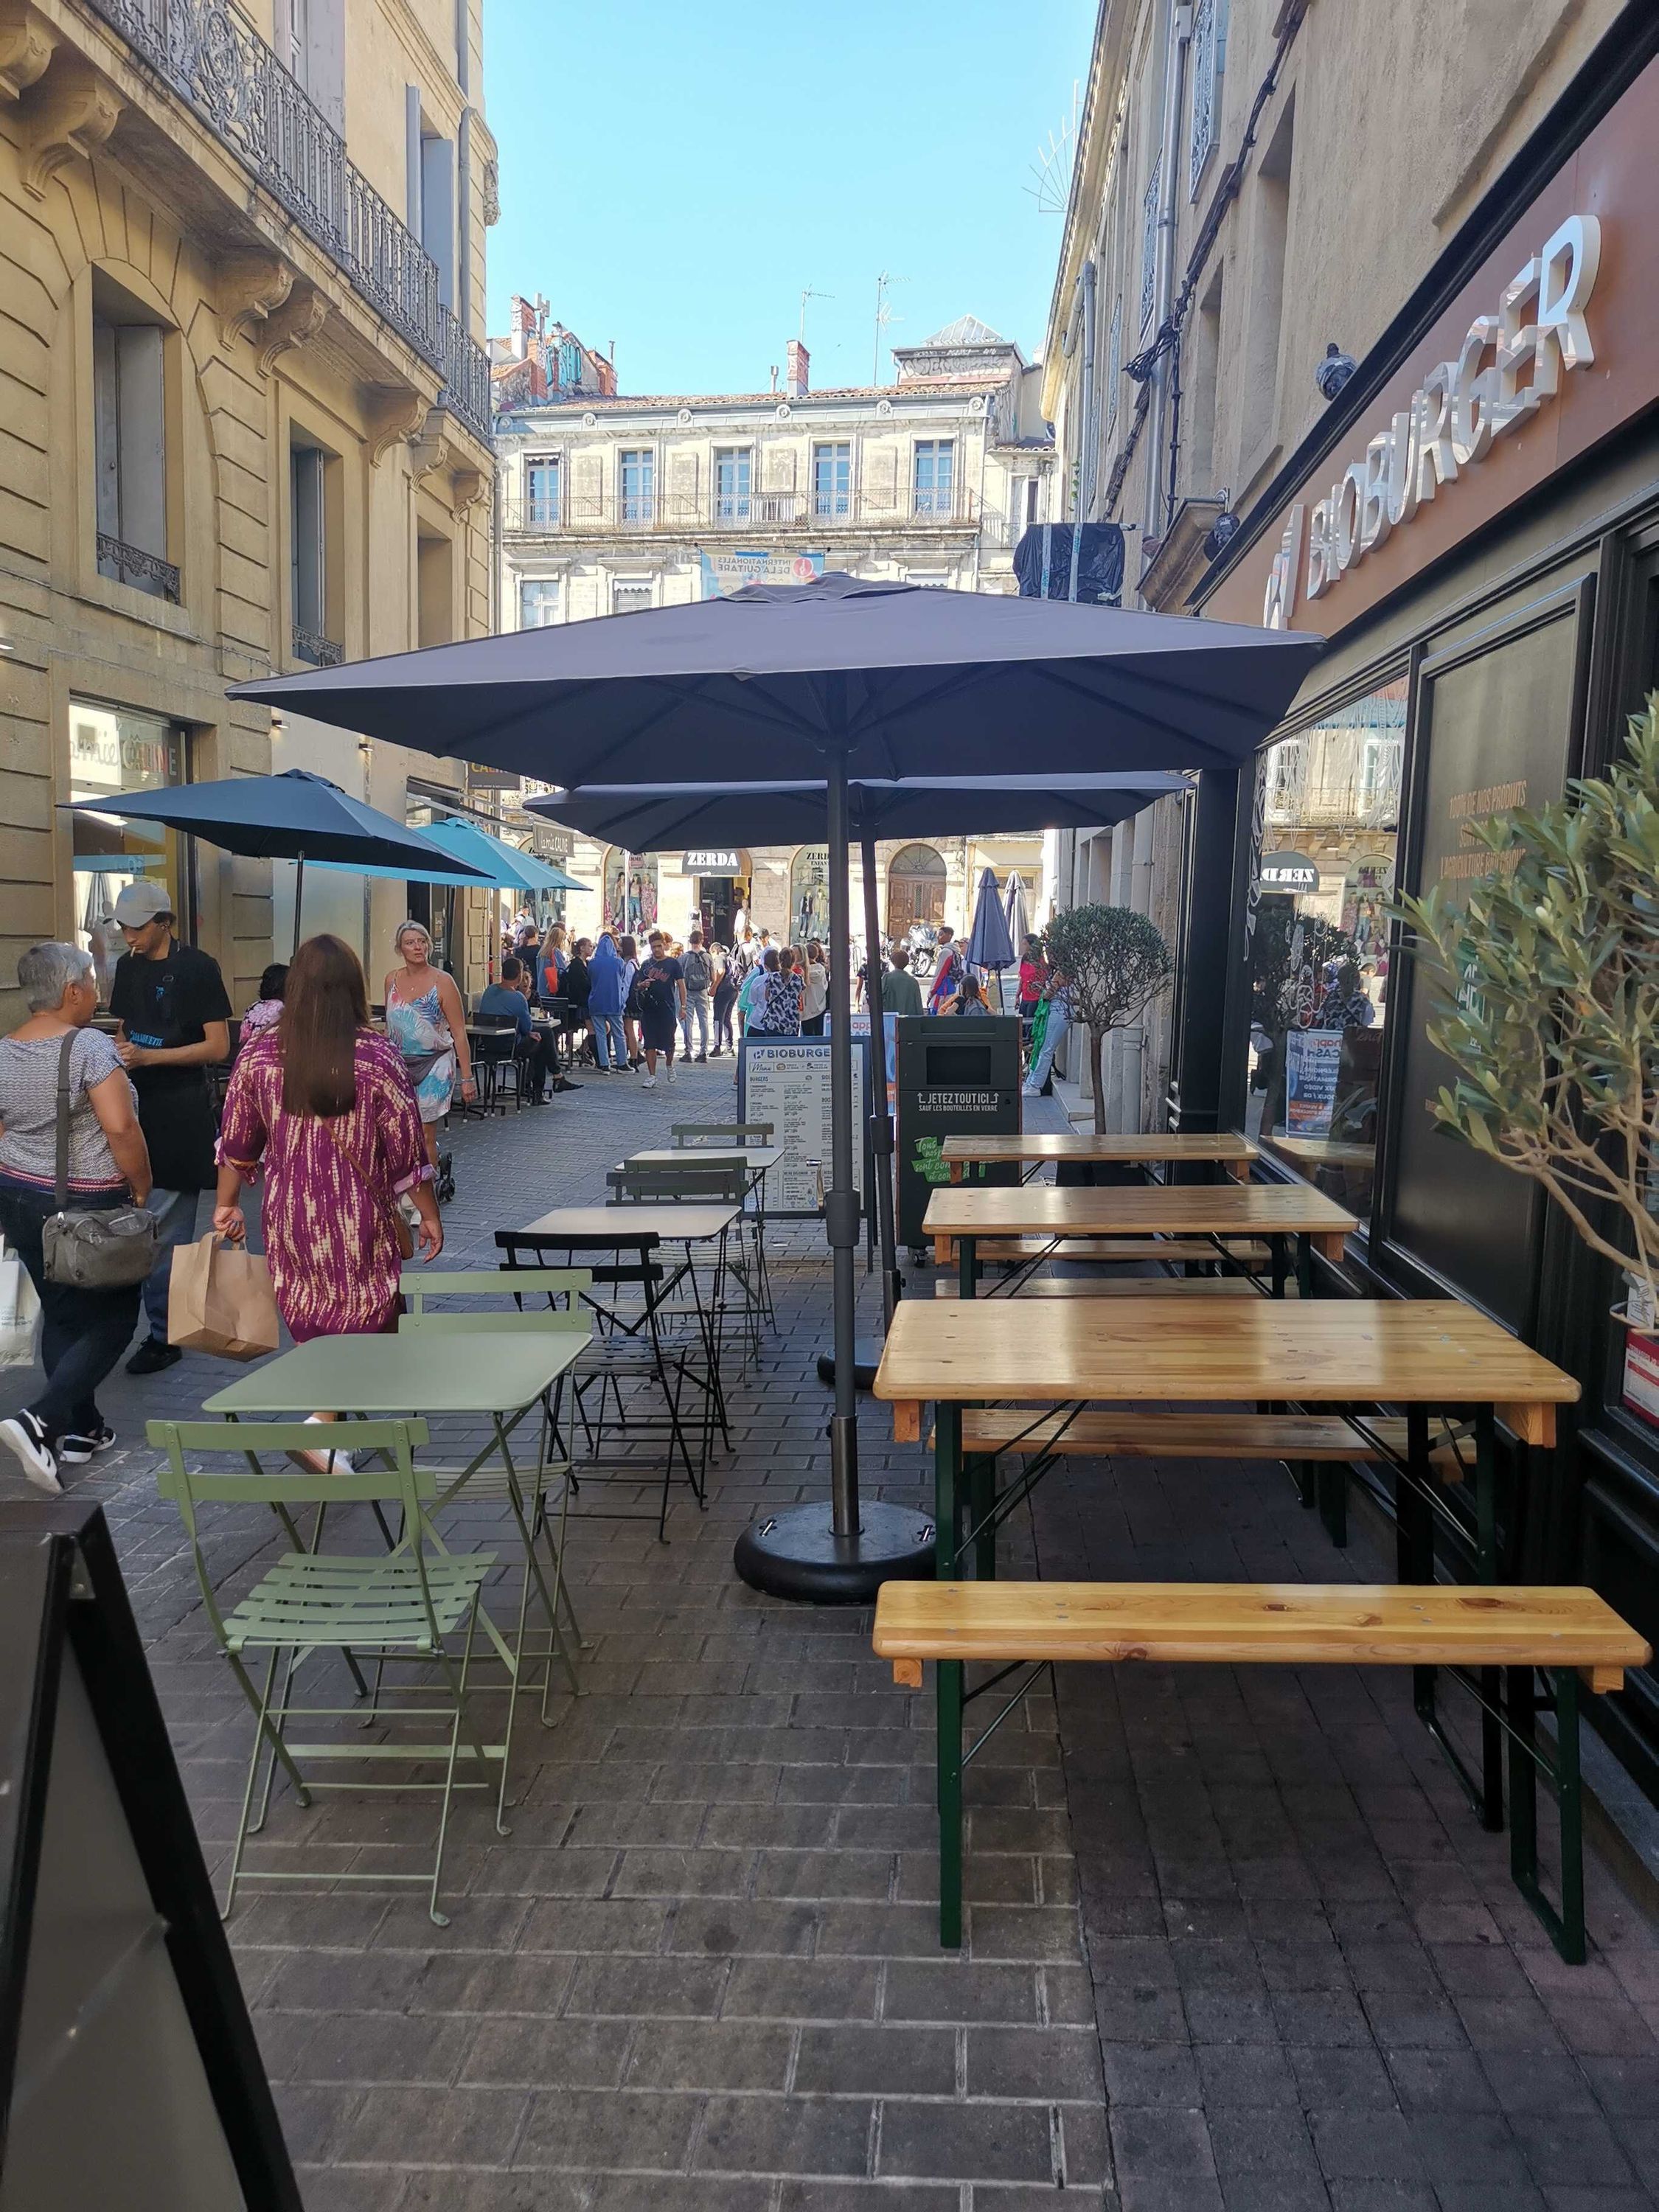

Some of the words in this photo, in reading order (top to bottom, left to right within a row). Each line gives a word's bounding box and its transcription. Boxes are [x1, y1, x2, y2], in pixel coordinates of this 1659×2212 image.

[1307, 215, 1602, 600] BIOBURGER
[1491, 779, 1528, 813] PRODUITS
[687, 849, 738, 868] ZERDA
[927, 1093, 953, 1105] JETEZ
[953, 1093, 977, 1105] TOUT
[978, 1093, 990, 1105] ICI
[914, 1136, 937, 1152] Tous
